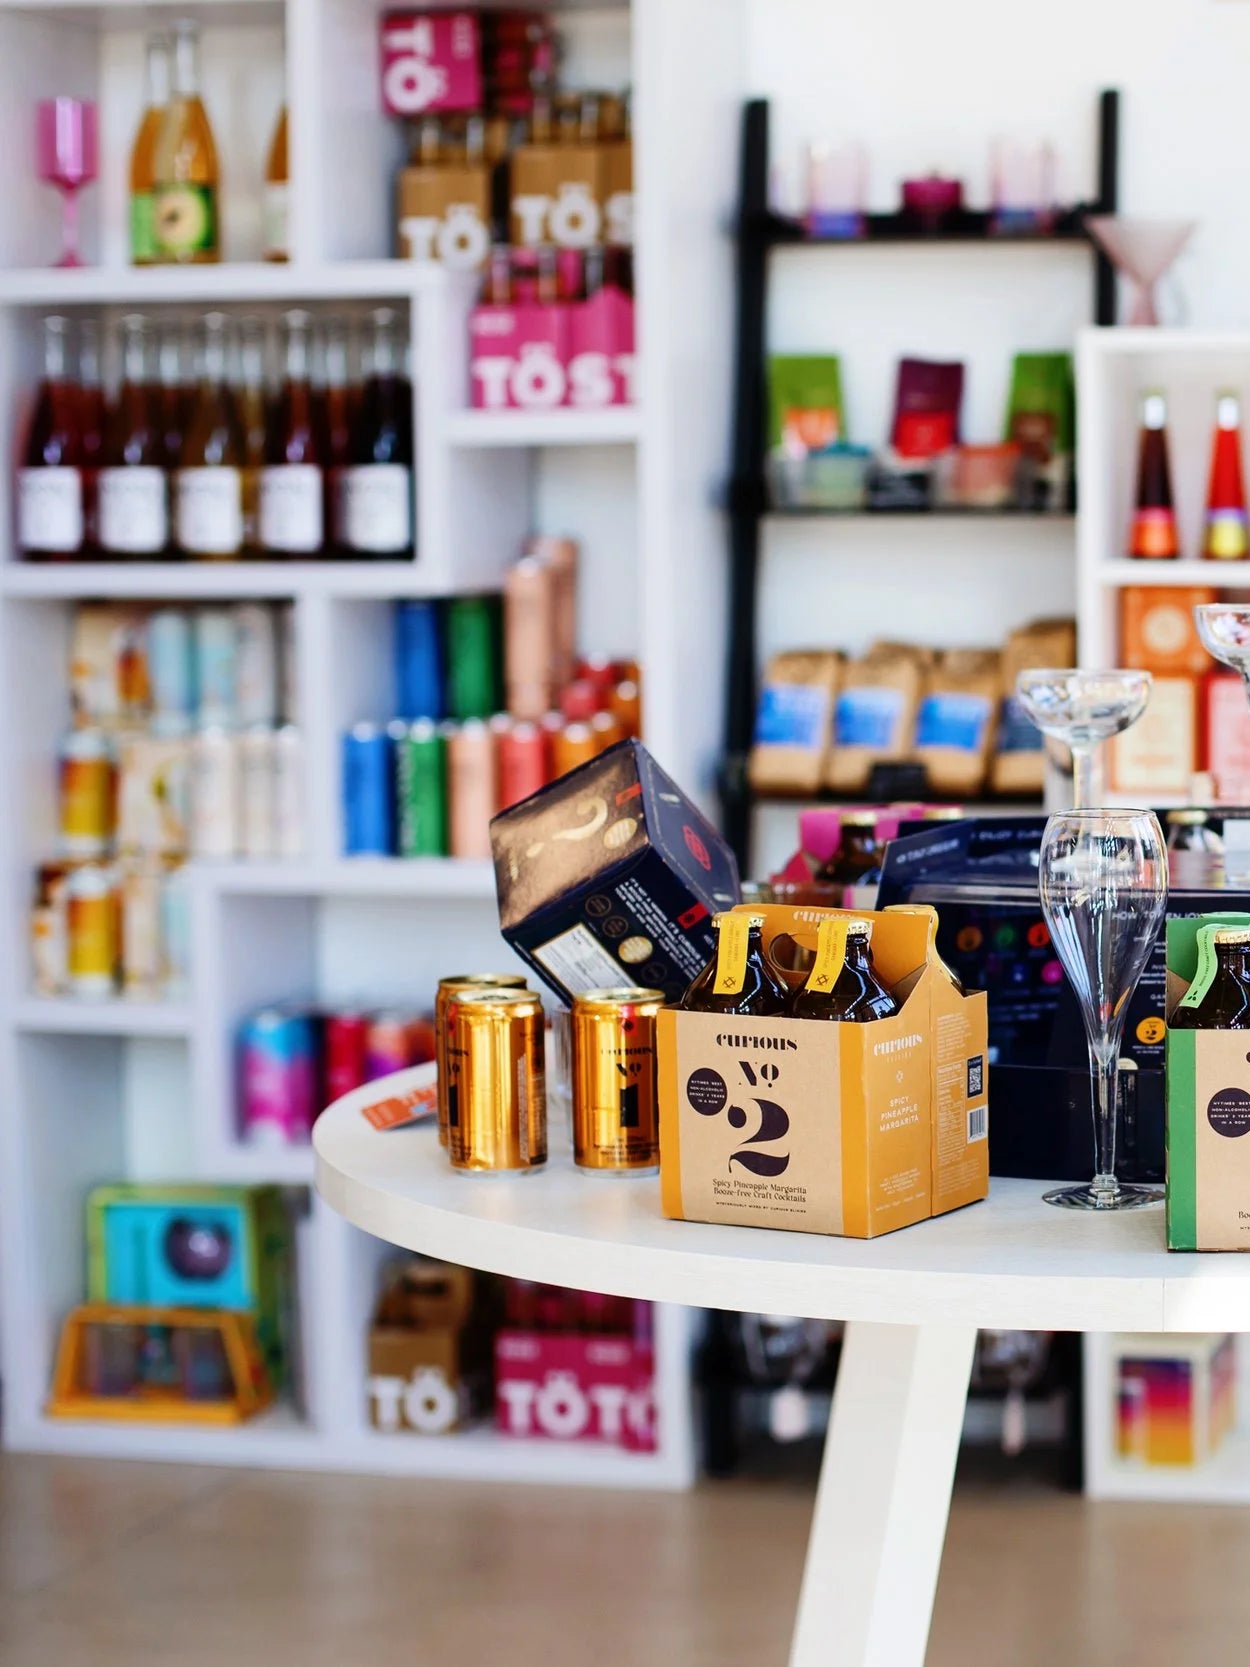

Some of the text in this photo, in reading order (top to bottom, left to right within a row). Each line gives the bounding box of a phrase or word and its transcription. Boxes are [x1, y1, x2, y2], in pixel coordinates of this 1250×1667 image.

[716, 1033, 798, 1051] curious
[889, 1096, 910, 1108] SPICY
[880, 1105, 919, 1121] PINEAPPLE
[879, 1115, 920, 1132] MARGARITA
[727, 1098, 790, 1177] 2
[712, 1178, 807, 1195] Spicy Pineapple Margarita
[713, 1187, 807, 1203] Booze-free Craft Cocktails
